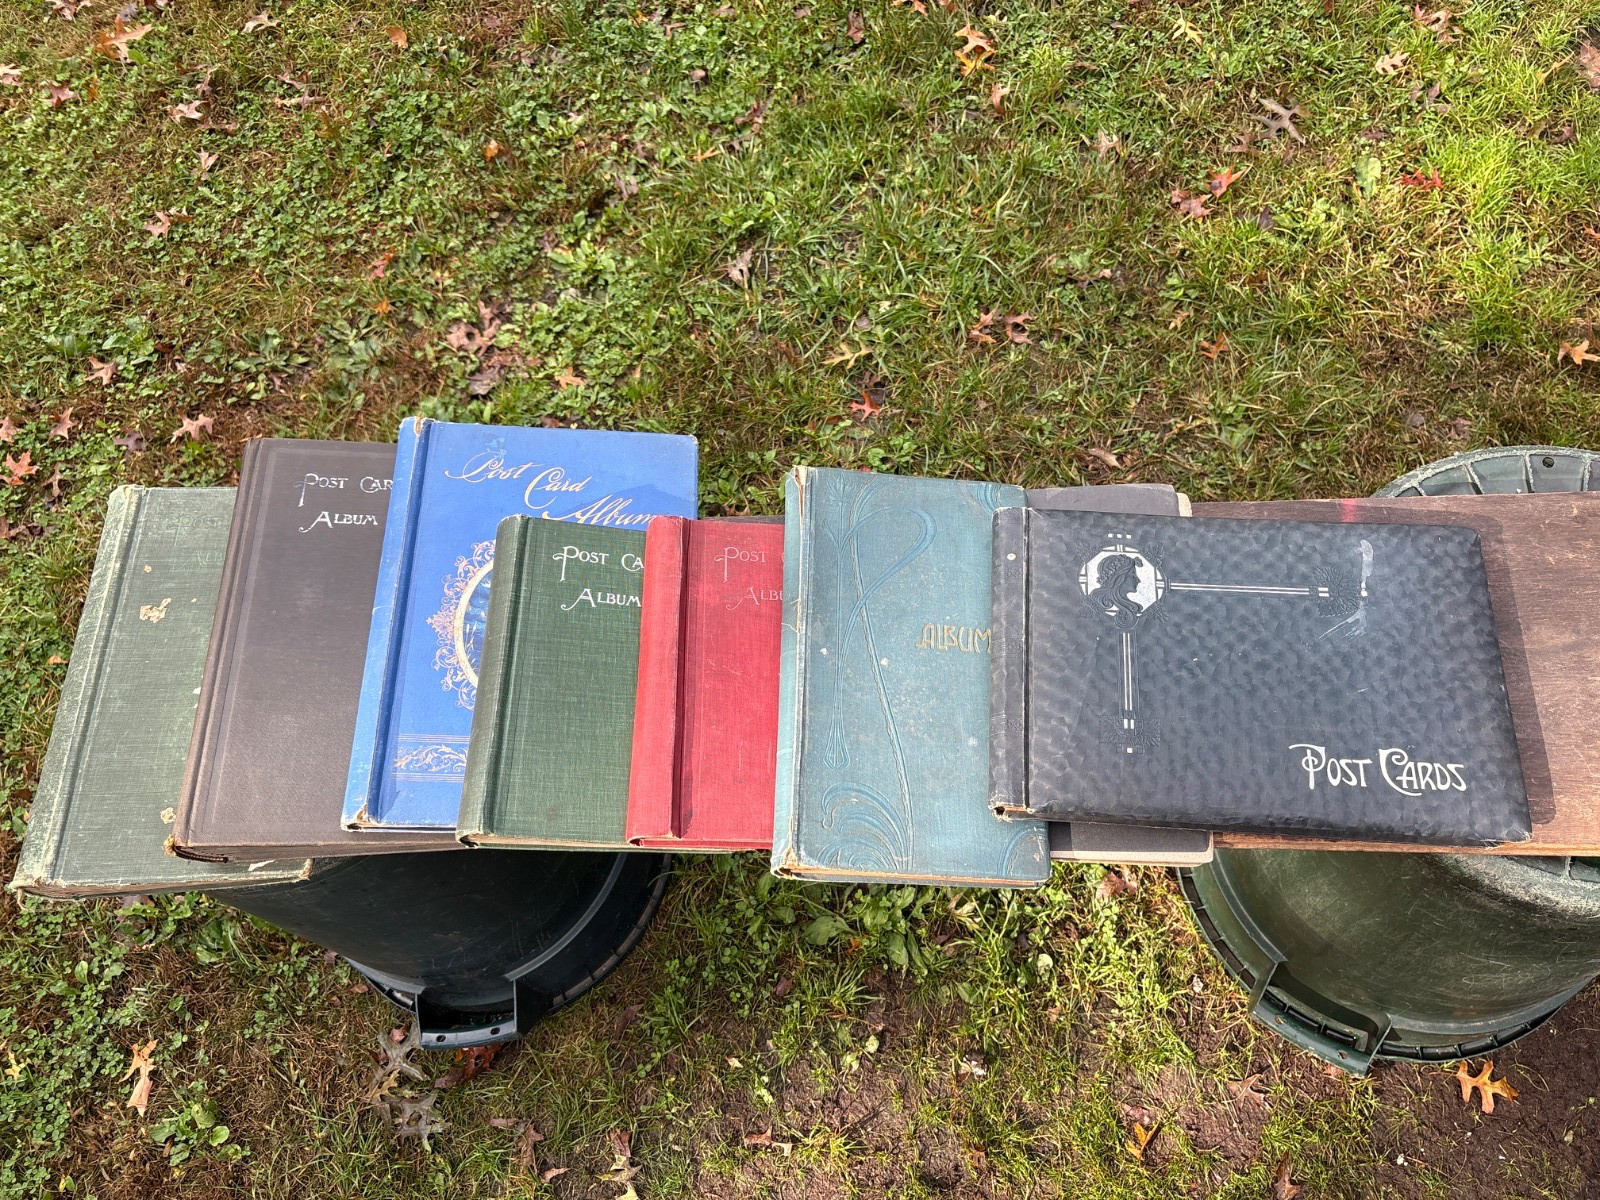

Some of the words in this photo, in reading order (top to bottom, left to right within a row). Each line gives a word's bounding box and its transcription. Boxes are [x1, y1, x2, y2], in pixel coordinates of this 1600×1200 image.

[293, 473, 349, 508] POST
[445, 451, 544, 483] Post
[524, 466, 592, 510] Card
[299, 511, 379, 533] ALBUM
[542, 494, 656, 527] Album
[552, 545, 610, 582] POST
[713, 546, 769, 584] POST
[560, 588, 642, 611] ALBUM
[915, 623, 992, 654] ALBUM
[1288, 743, 1374, 790] POST
[1378, 748, 1467, 796] CARDS
